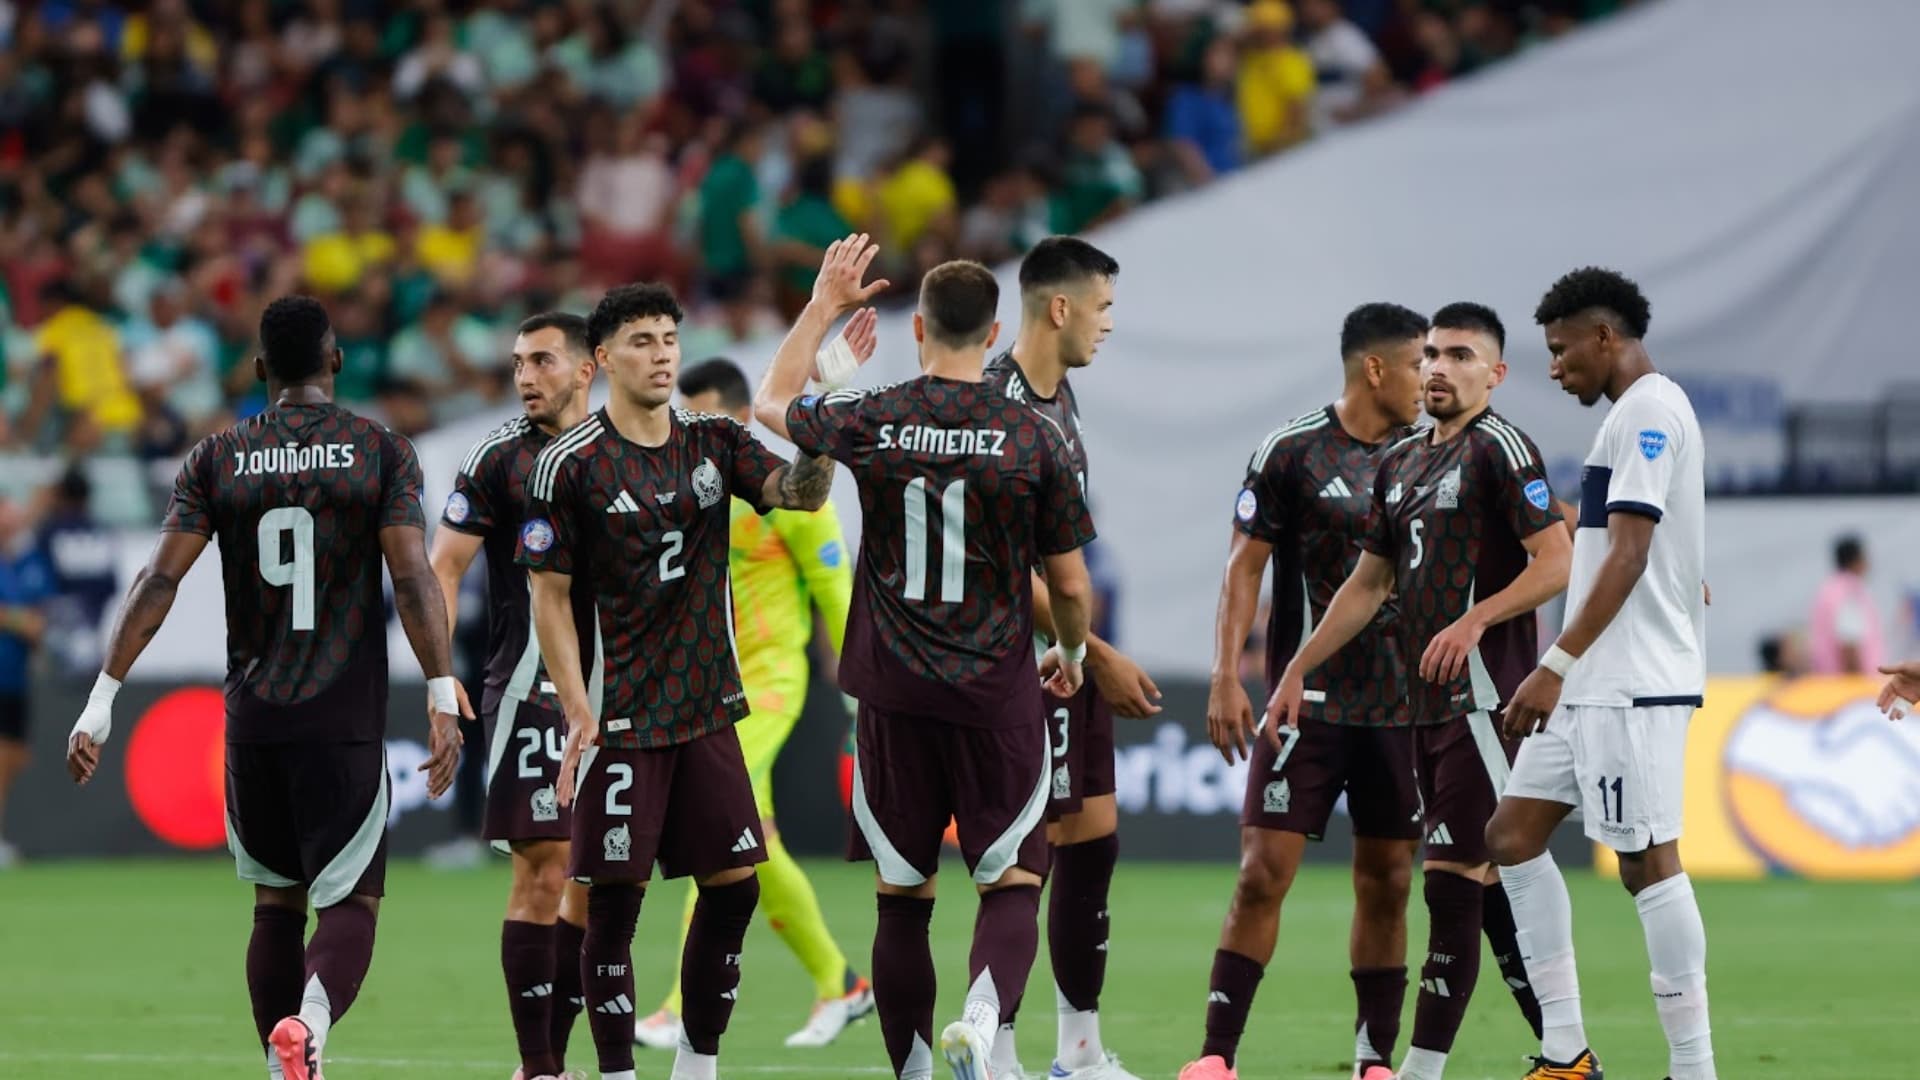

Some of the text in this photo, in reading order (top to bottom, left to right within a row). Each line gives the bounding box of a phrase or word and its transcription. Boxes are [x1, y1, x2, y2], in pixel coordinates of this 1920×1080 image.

[234, 442, 354, 477] J.QUIÑONES
[878, 424, 1006, 456] S.GIMENEZ
[659, 530, 685, 581] 2
[904, 476, 966, 602] 11
[1410, 518, 1424, 569] 5
[258, 506, 315, 630] 9
[516, 727, 567, 778] 24
[1053, 708, 1069, 758] 3
[1271, 725, 1301, 772] 7
[606, 763, 633, 815] 2
[1598, 776, 1623, 823] 11
